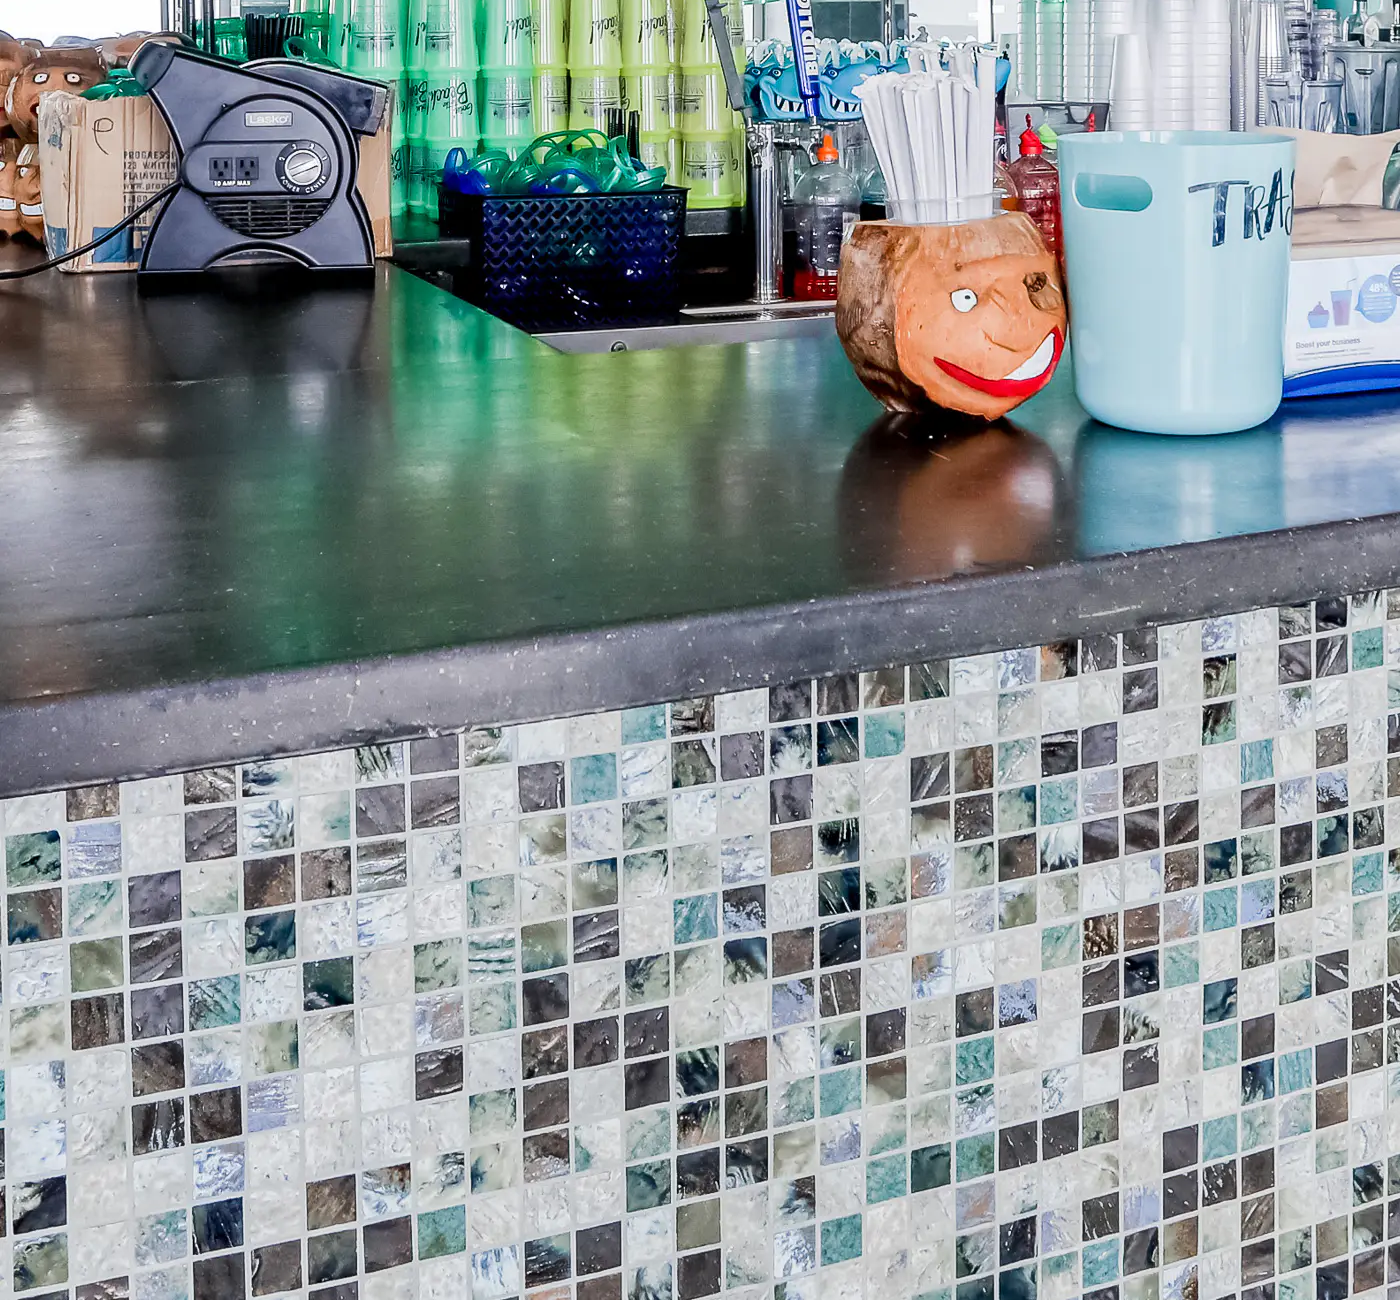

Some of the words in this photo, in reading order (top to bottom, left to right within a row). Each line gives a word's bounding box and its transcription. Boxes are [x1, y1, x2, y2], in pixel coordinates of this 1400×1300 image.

[801, 29, 819, 77] BUD
[249, 114, 290, 125] Lasko
[280, 175, 301, 193] POWER
[304, 175, 327, 194] CENTER
[1316, 339, 1331, 349] your
[1331, 338, 1361, 346] business
